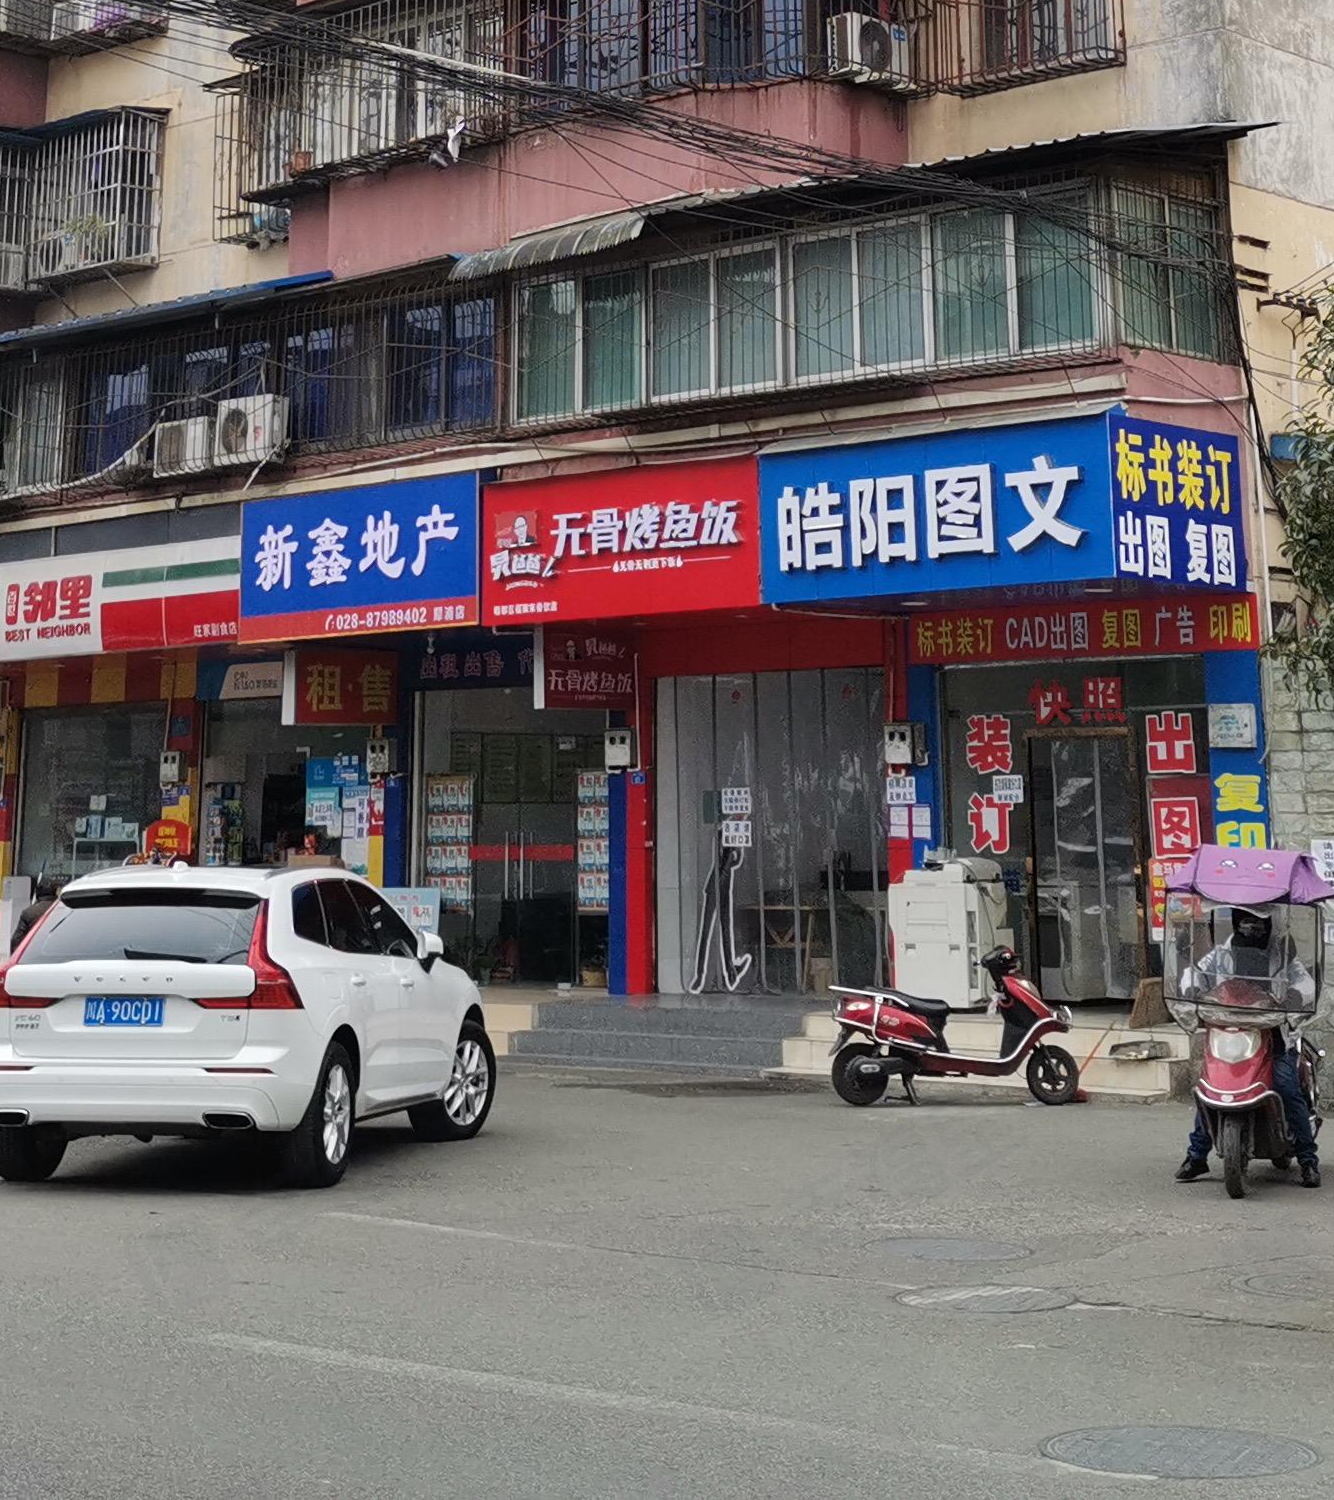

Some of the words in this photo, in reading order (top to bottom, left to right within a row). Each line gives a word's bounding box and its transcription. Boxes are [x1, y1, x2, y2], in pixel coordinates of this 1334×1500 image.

[1115, 428, 1232, 516] 标书装订
[550, 499, 742, 557] 无骨烤鱼饭
[776, 455, 1088, 572] 皓阳图文
[254, 503, 460, 592] 新鑫地产
[1117, 510, 1172, 579] 出图
[1186, 518, 1236, 587] 复图
[23, 574, 93, 623] 邻里
[336, 607, 427, 631] 028-87989402
[917, 616, 994, 657] 标书装订
[1005, 611, 1089, 652] CAD出图
[1101, 609, 1142, 649] 复图
[1154, 604, 1196, 646] 广告
[1208, 601, 1252, 645] 印刷
[5, 628, 31, 643] BEST
[37, 622, 92, 640] NEIGHBOR
[548, 669, 633, 694] 无骨烤鱼饭
[967, 714, 1014, 854] 装订
[1145, 710, 1202, 859] 出图
